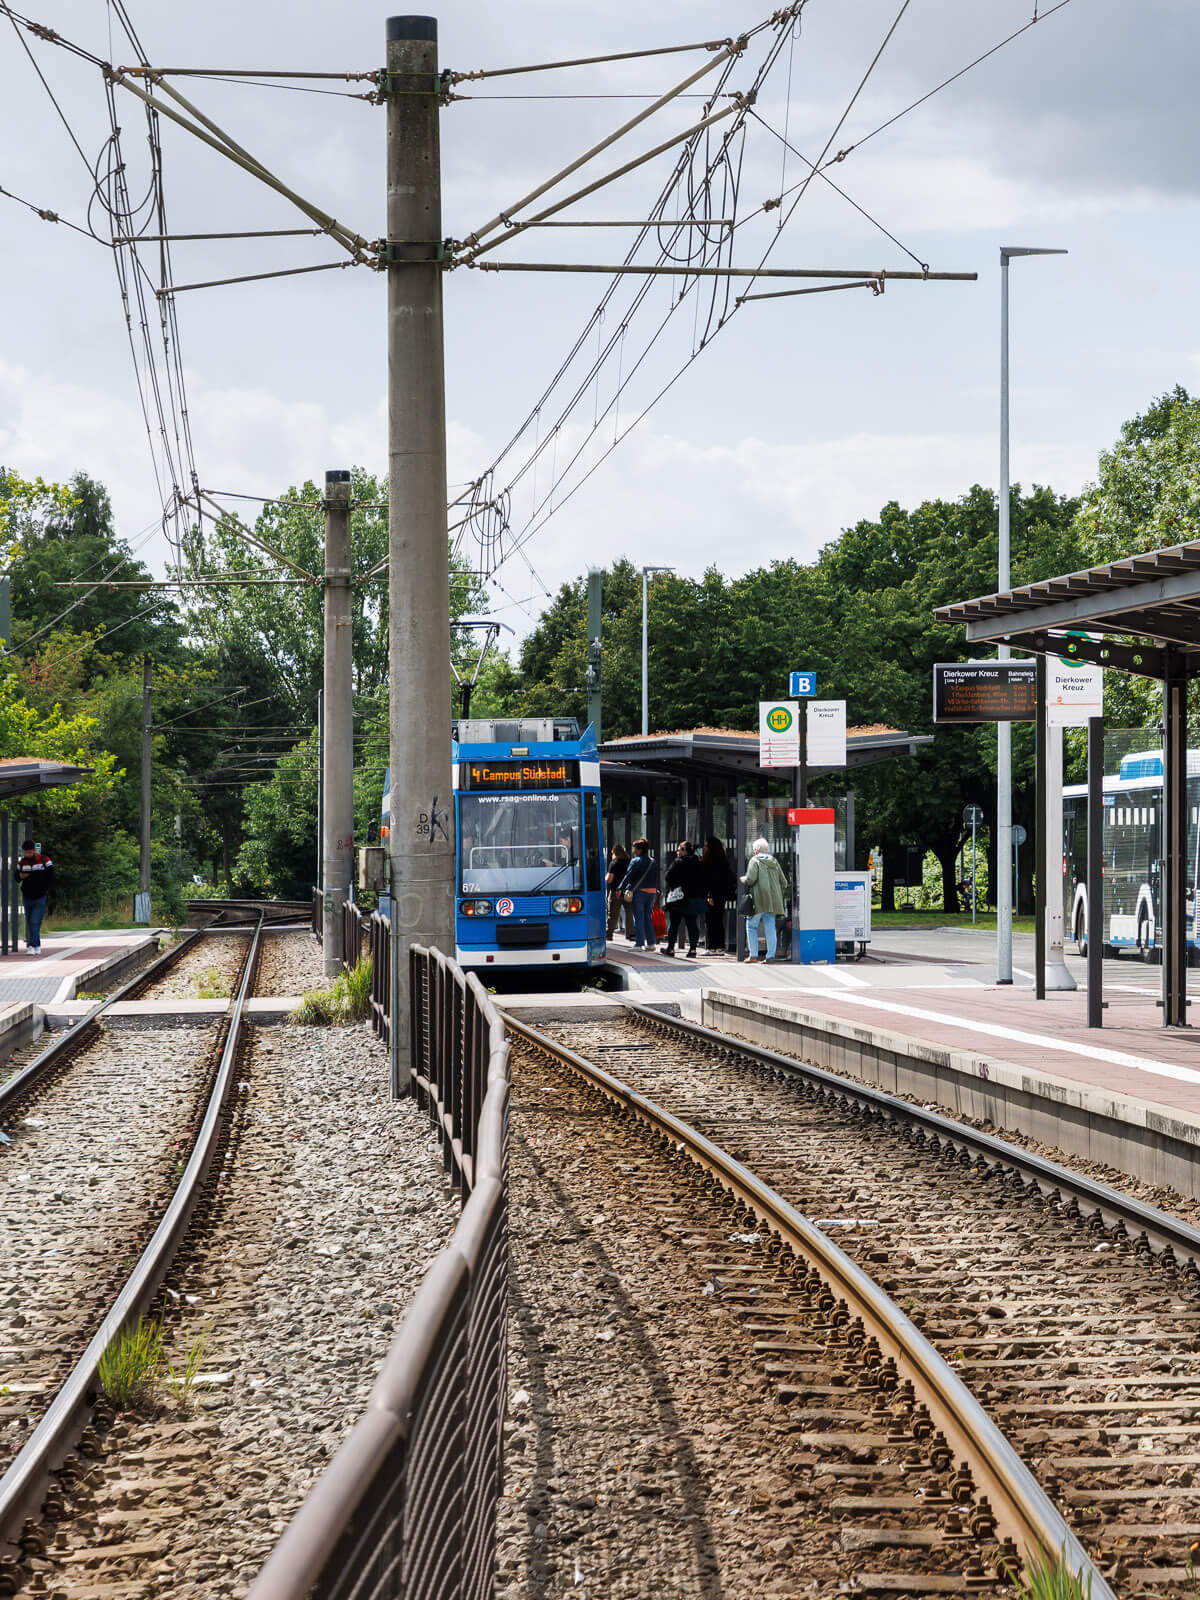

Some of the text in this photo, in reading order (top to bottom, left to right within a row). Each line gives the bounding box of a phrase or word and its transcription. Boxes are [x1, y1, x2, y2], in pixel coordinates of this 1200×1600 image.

[799, 678, 810, 692] B
[472, 767, 566, 782] 4 Campus Südstadt
[478, 794, 559, 803] www.rsag-online.de
[420, 814, 428, 823] D
[416, 825, 429, 834] 39
[463, 883, 480, 892] 674
